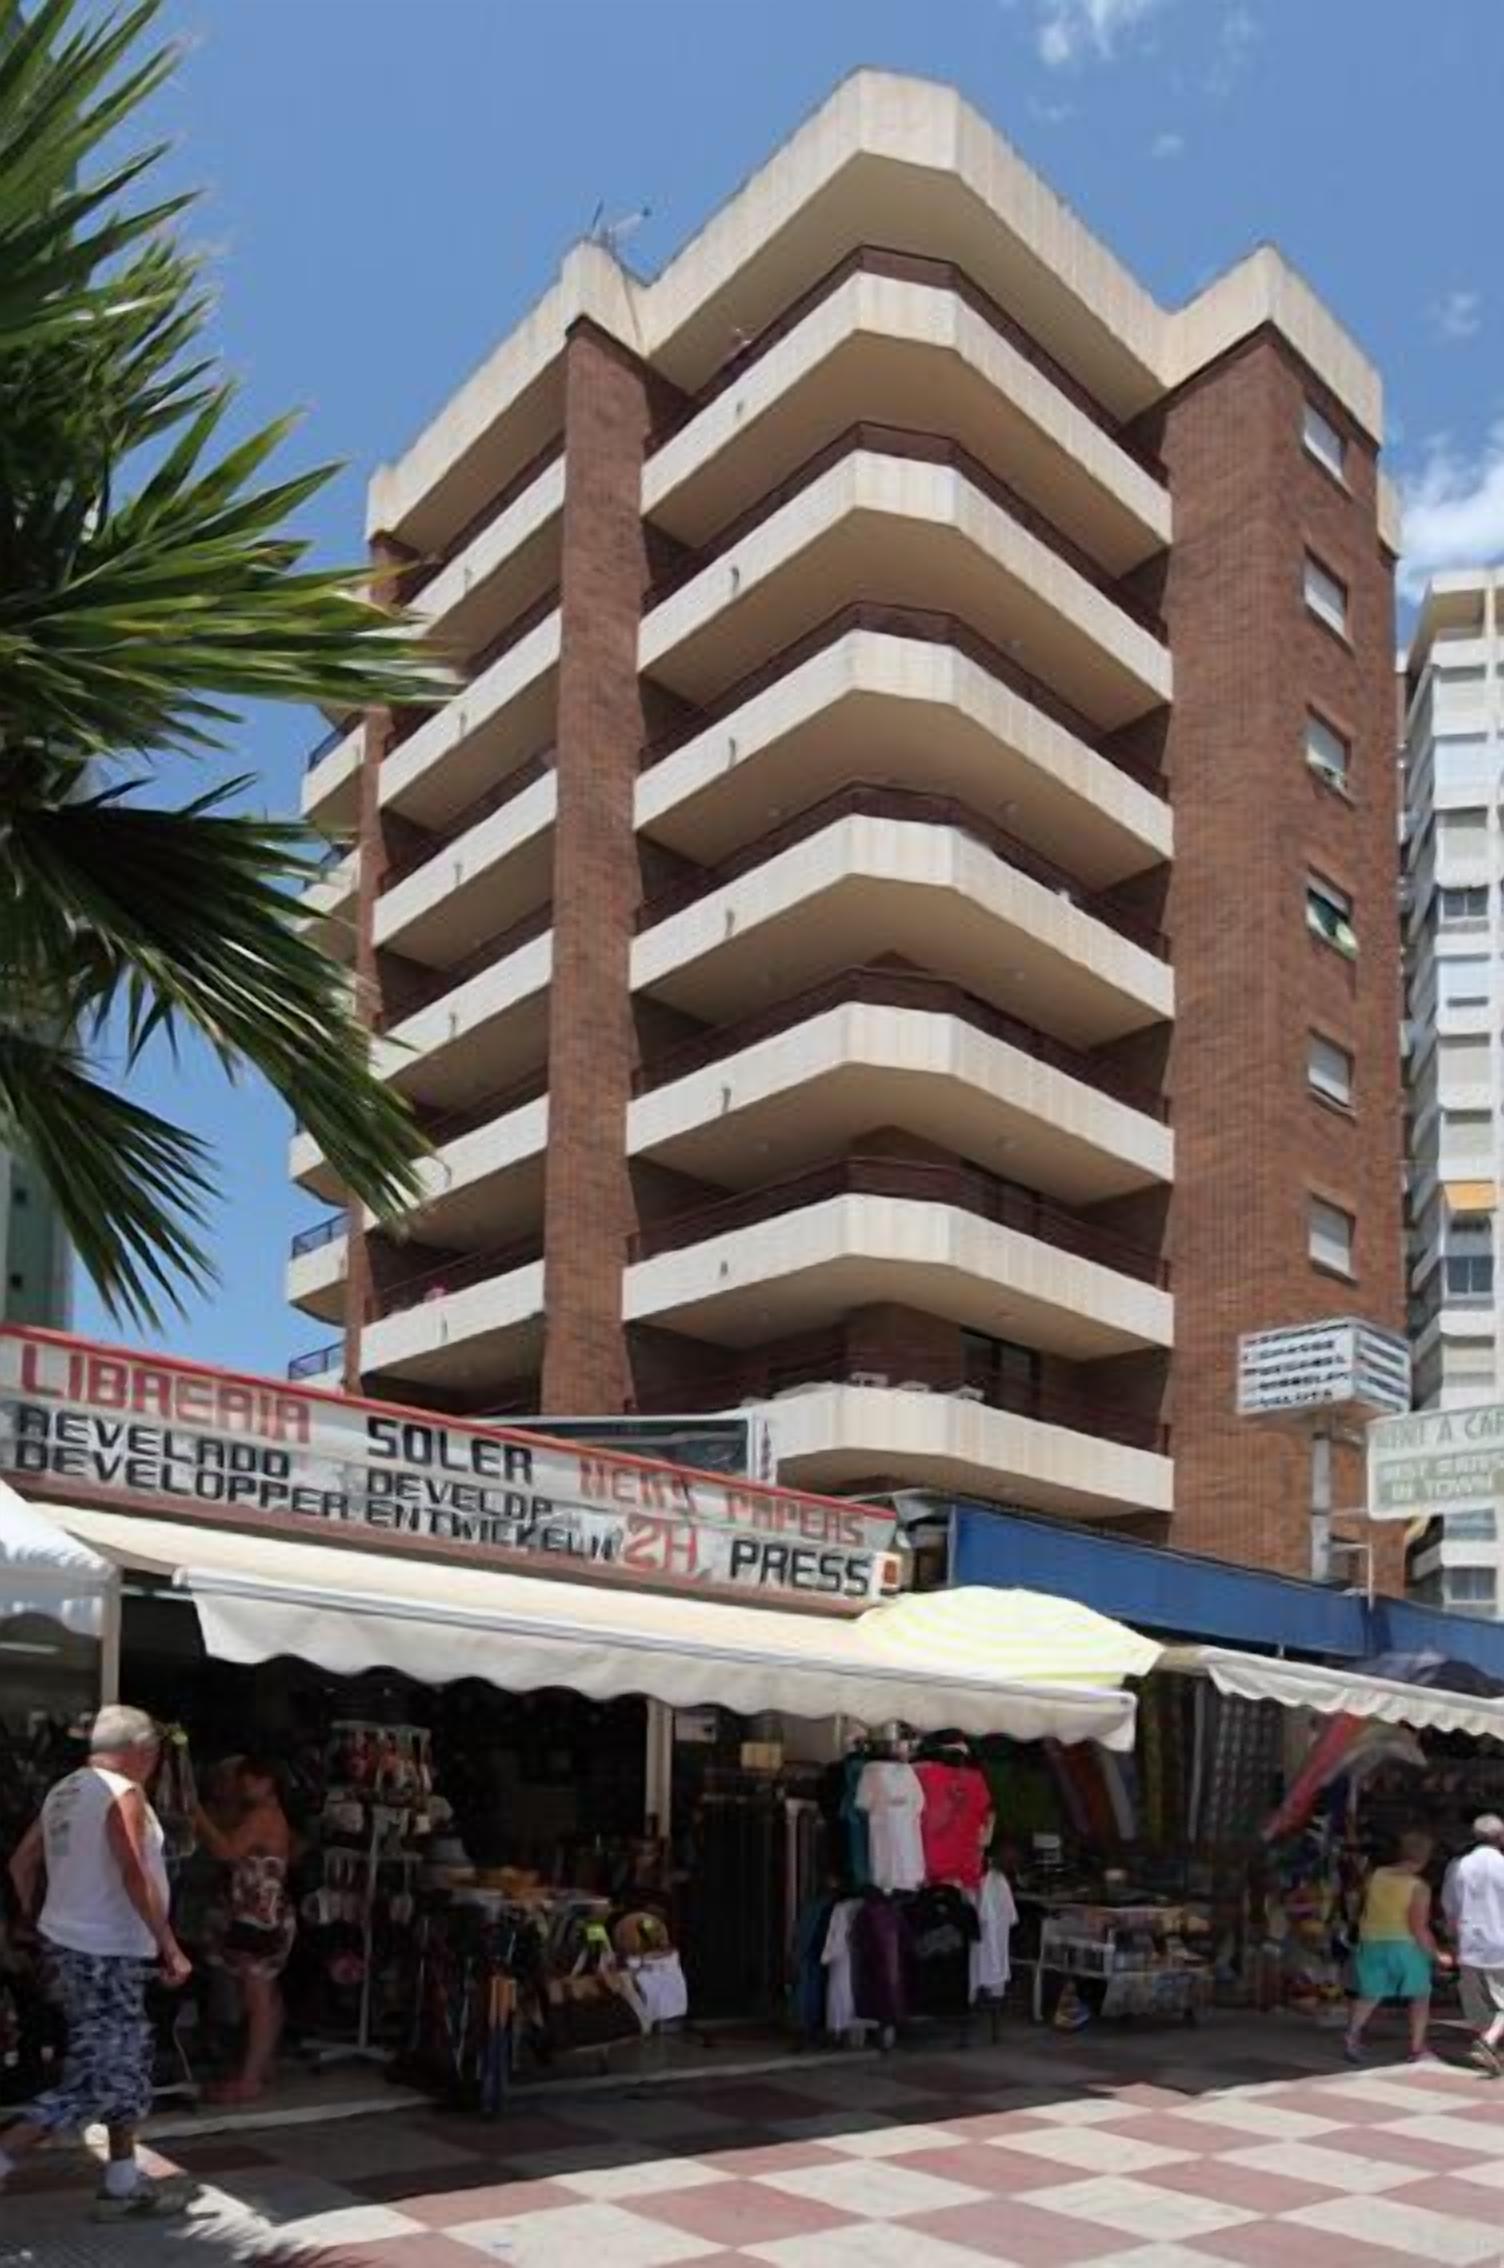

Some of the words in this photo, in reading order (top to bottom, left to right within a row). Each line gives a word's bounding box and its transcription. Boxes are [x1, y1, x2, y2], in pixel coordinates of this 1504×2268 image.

[15, 1403, 290, 1478] REVELADO
[20, 1344, 311, 1443] LIBRERIA
[366, 1416, 533, 1485] SOLER
[14, 1440, 349, 1519] DEVELOPPER
[730, 1539, 868, 1595] PRESS
